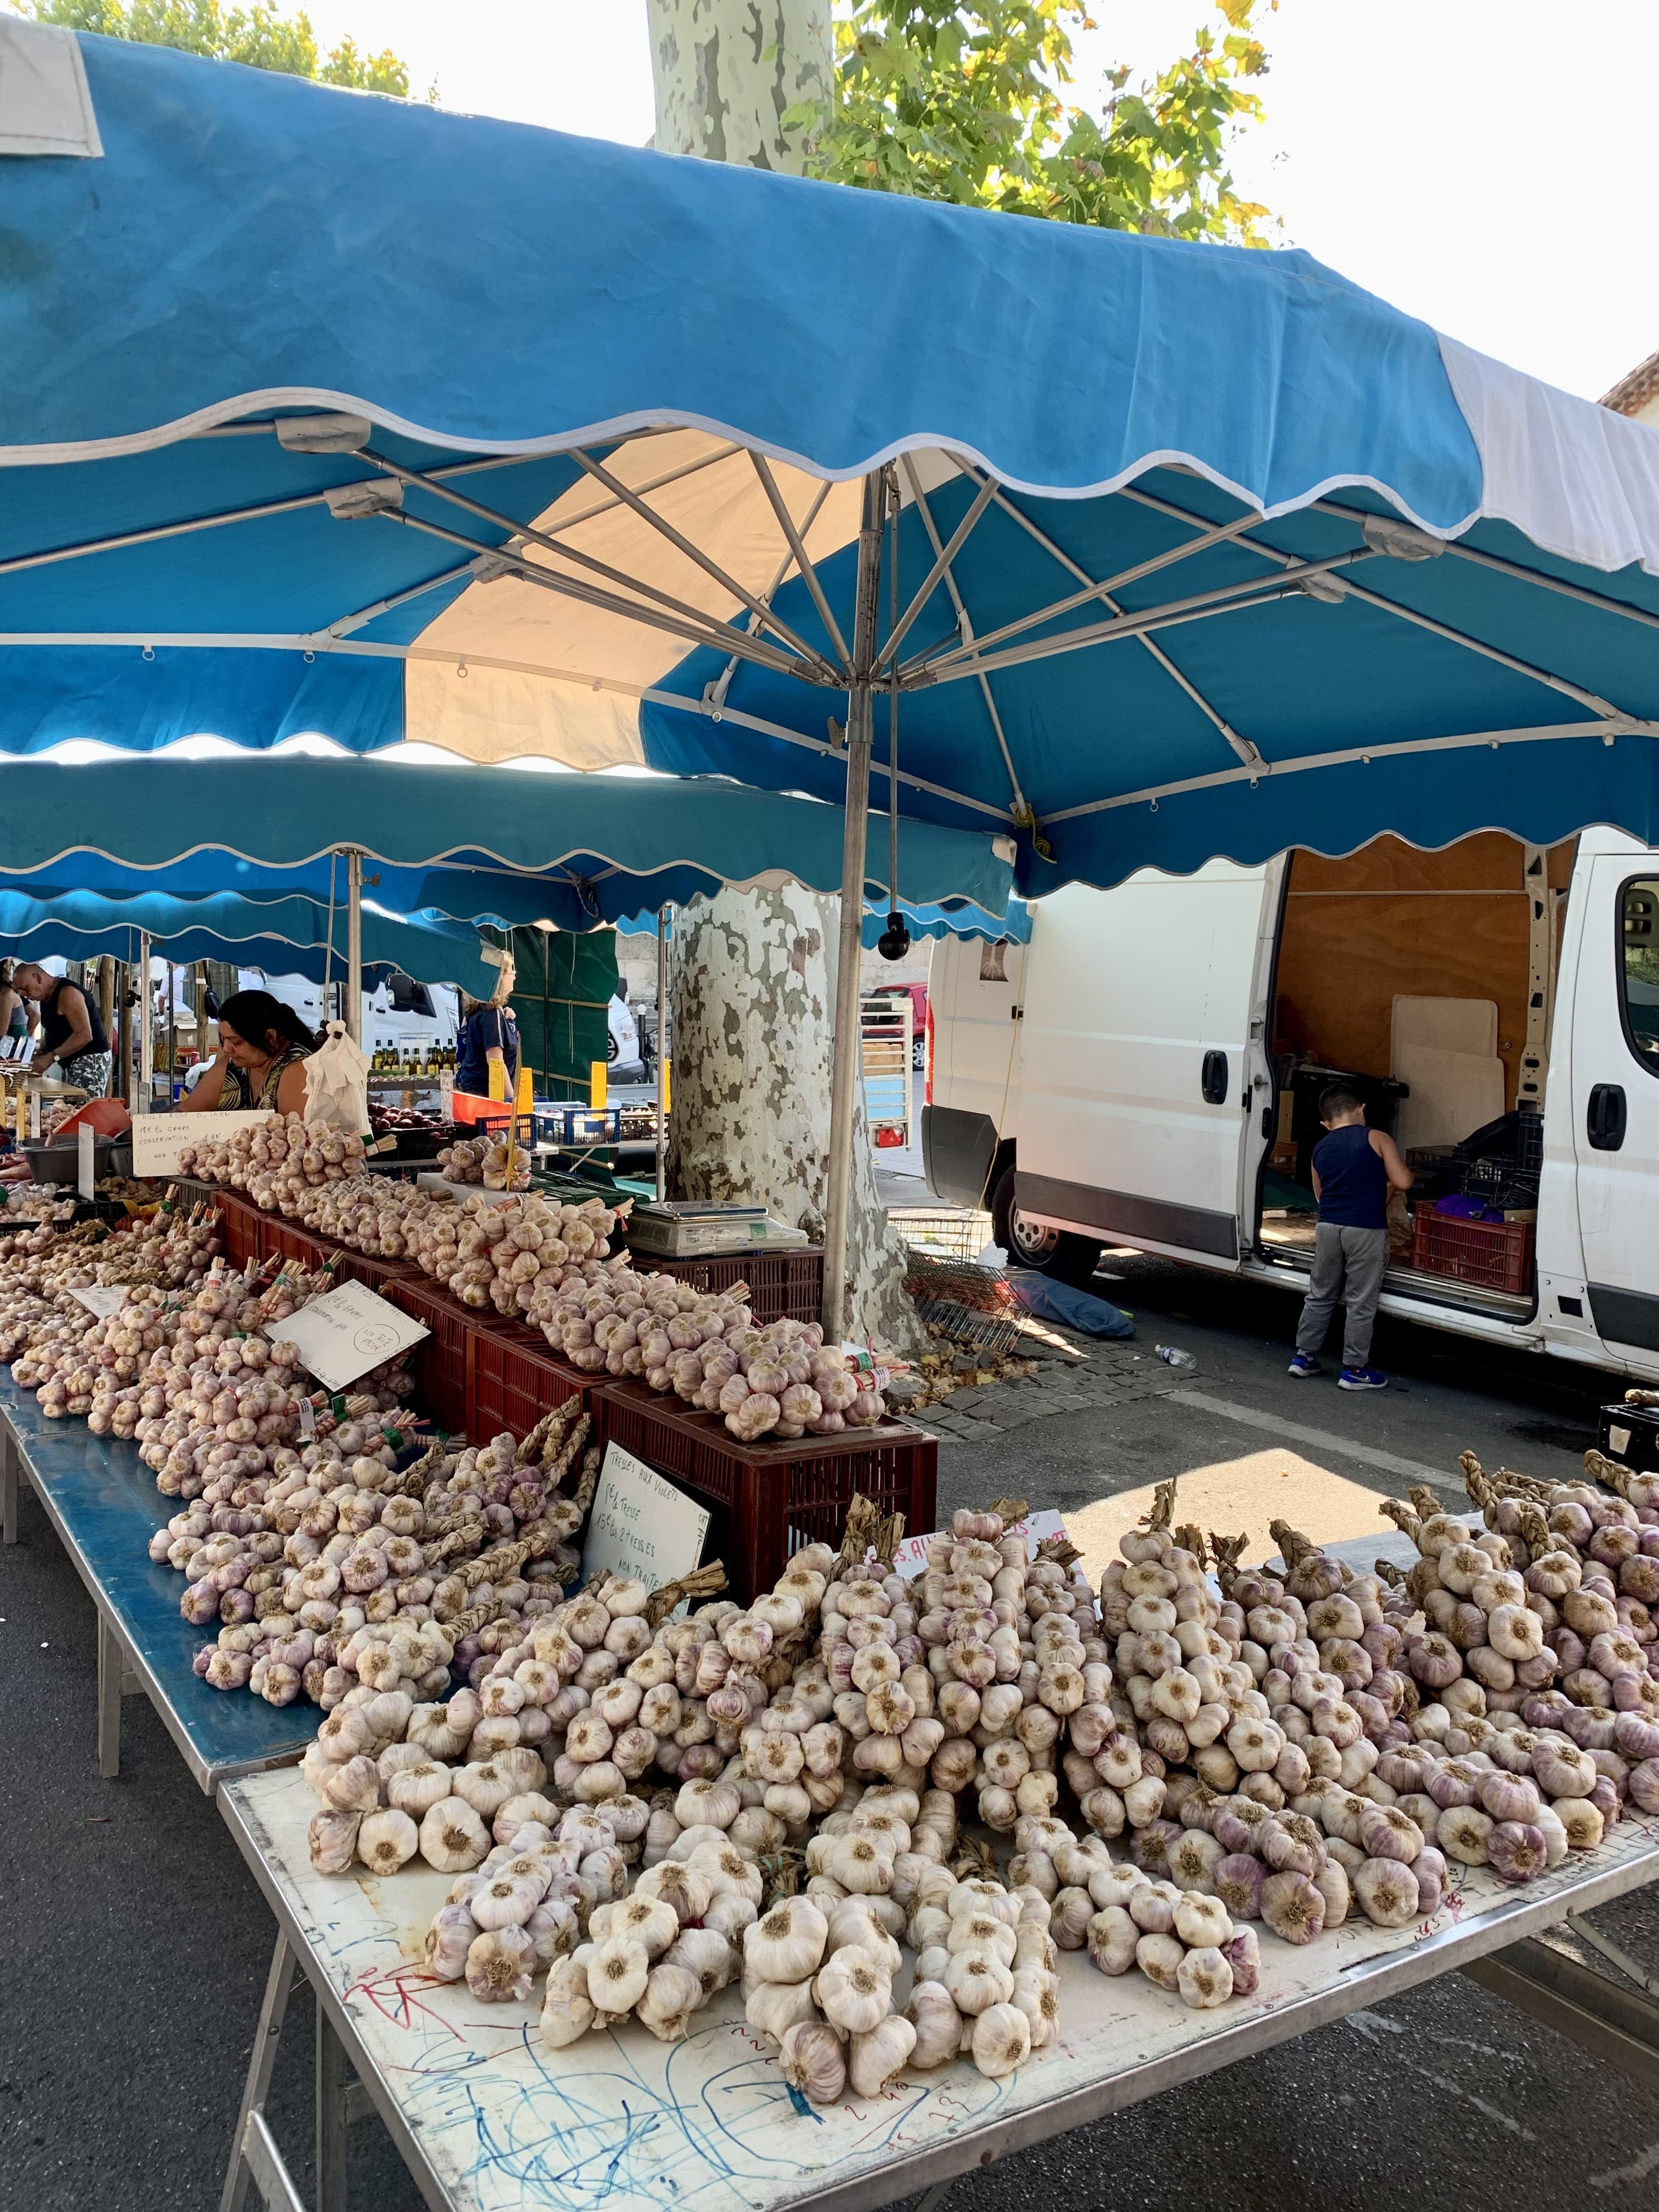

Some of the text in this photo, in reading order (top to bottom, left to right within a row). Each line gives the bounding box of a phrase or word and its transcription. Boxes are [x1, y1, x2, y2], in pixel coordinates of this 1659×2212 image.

[611, 1451, 635, 1473] TRESSES
[620, 1498, 641, 1521] TRESSE
[619, 1527, 625, 1542] 2
[618, 1558, 632, 1574] NON
